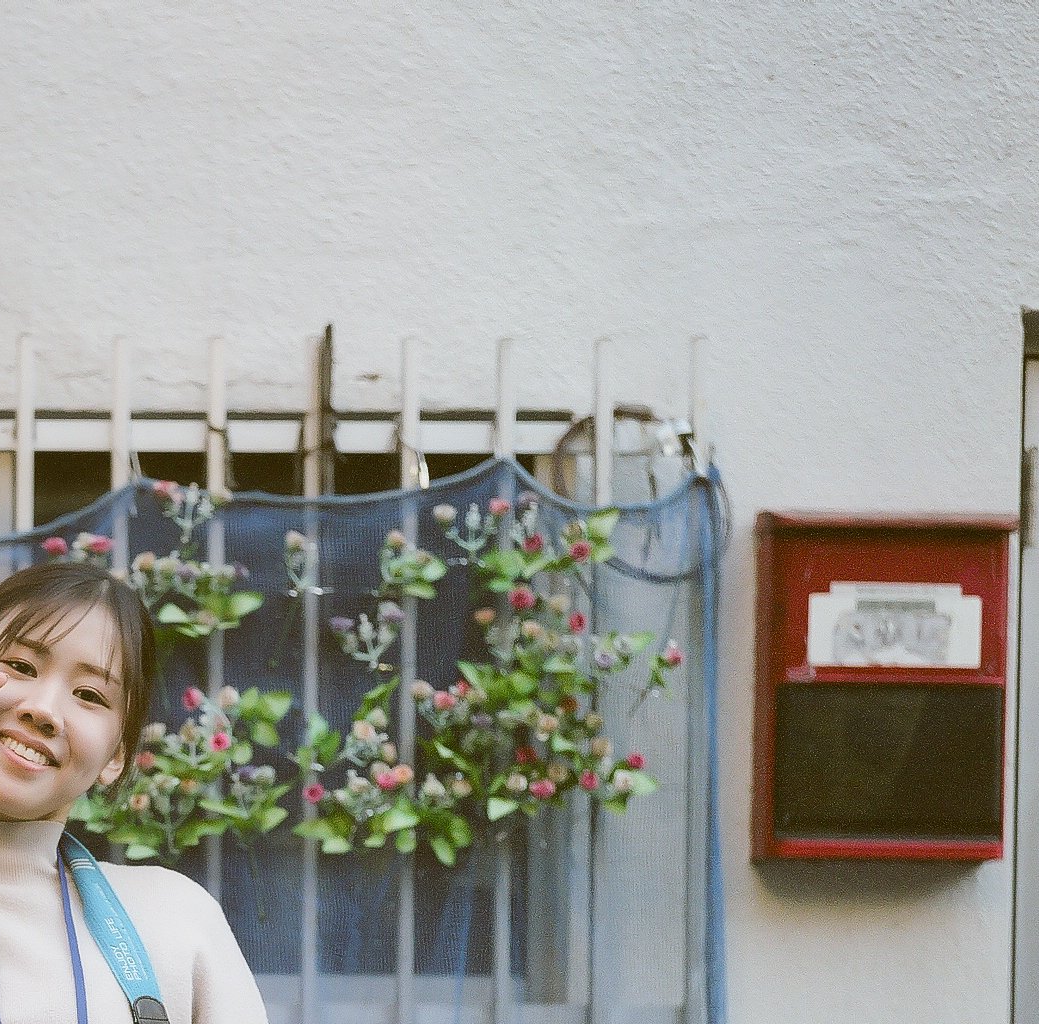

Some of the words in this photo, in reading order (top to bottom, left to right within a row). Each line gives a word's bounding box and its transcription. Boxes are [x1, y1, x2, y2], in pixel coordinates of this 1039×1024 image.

[105, 918, 121, 939] LIFE
[111, 945, 134, 980] ENJOY
[119, 942, 142, 981] PHOTO
